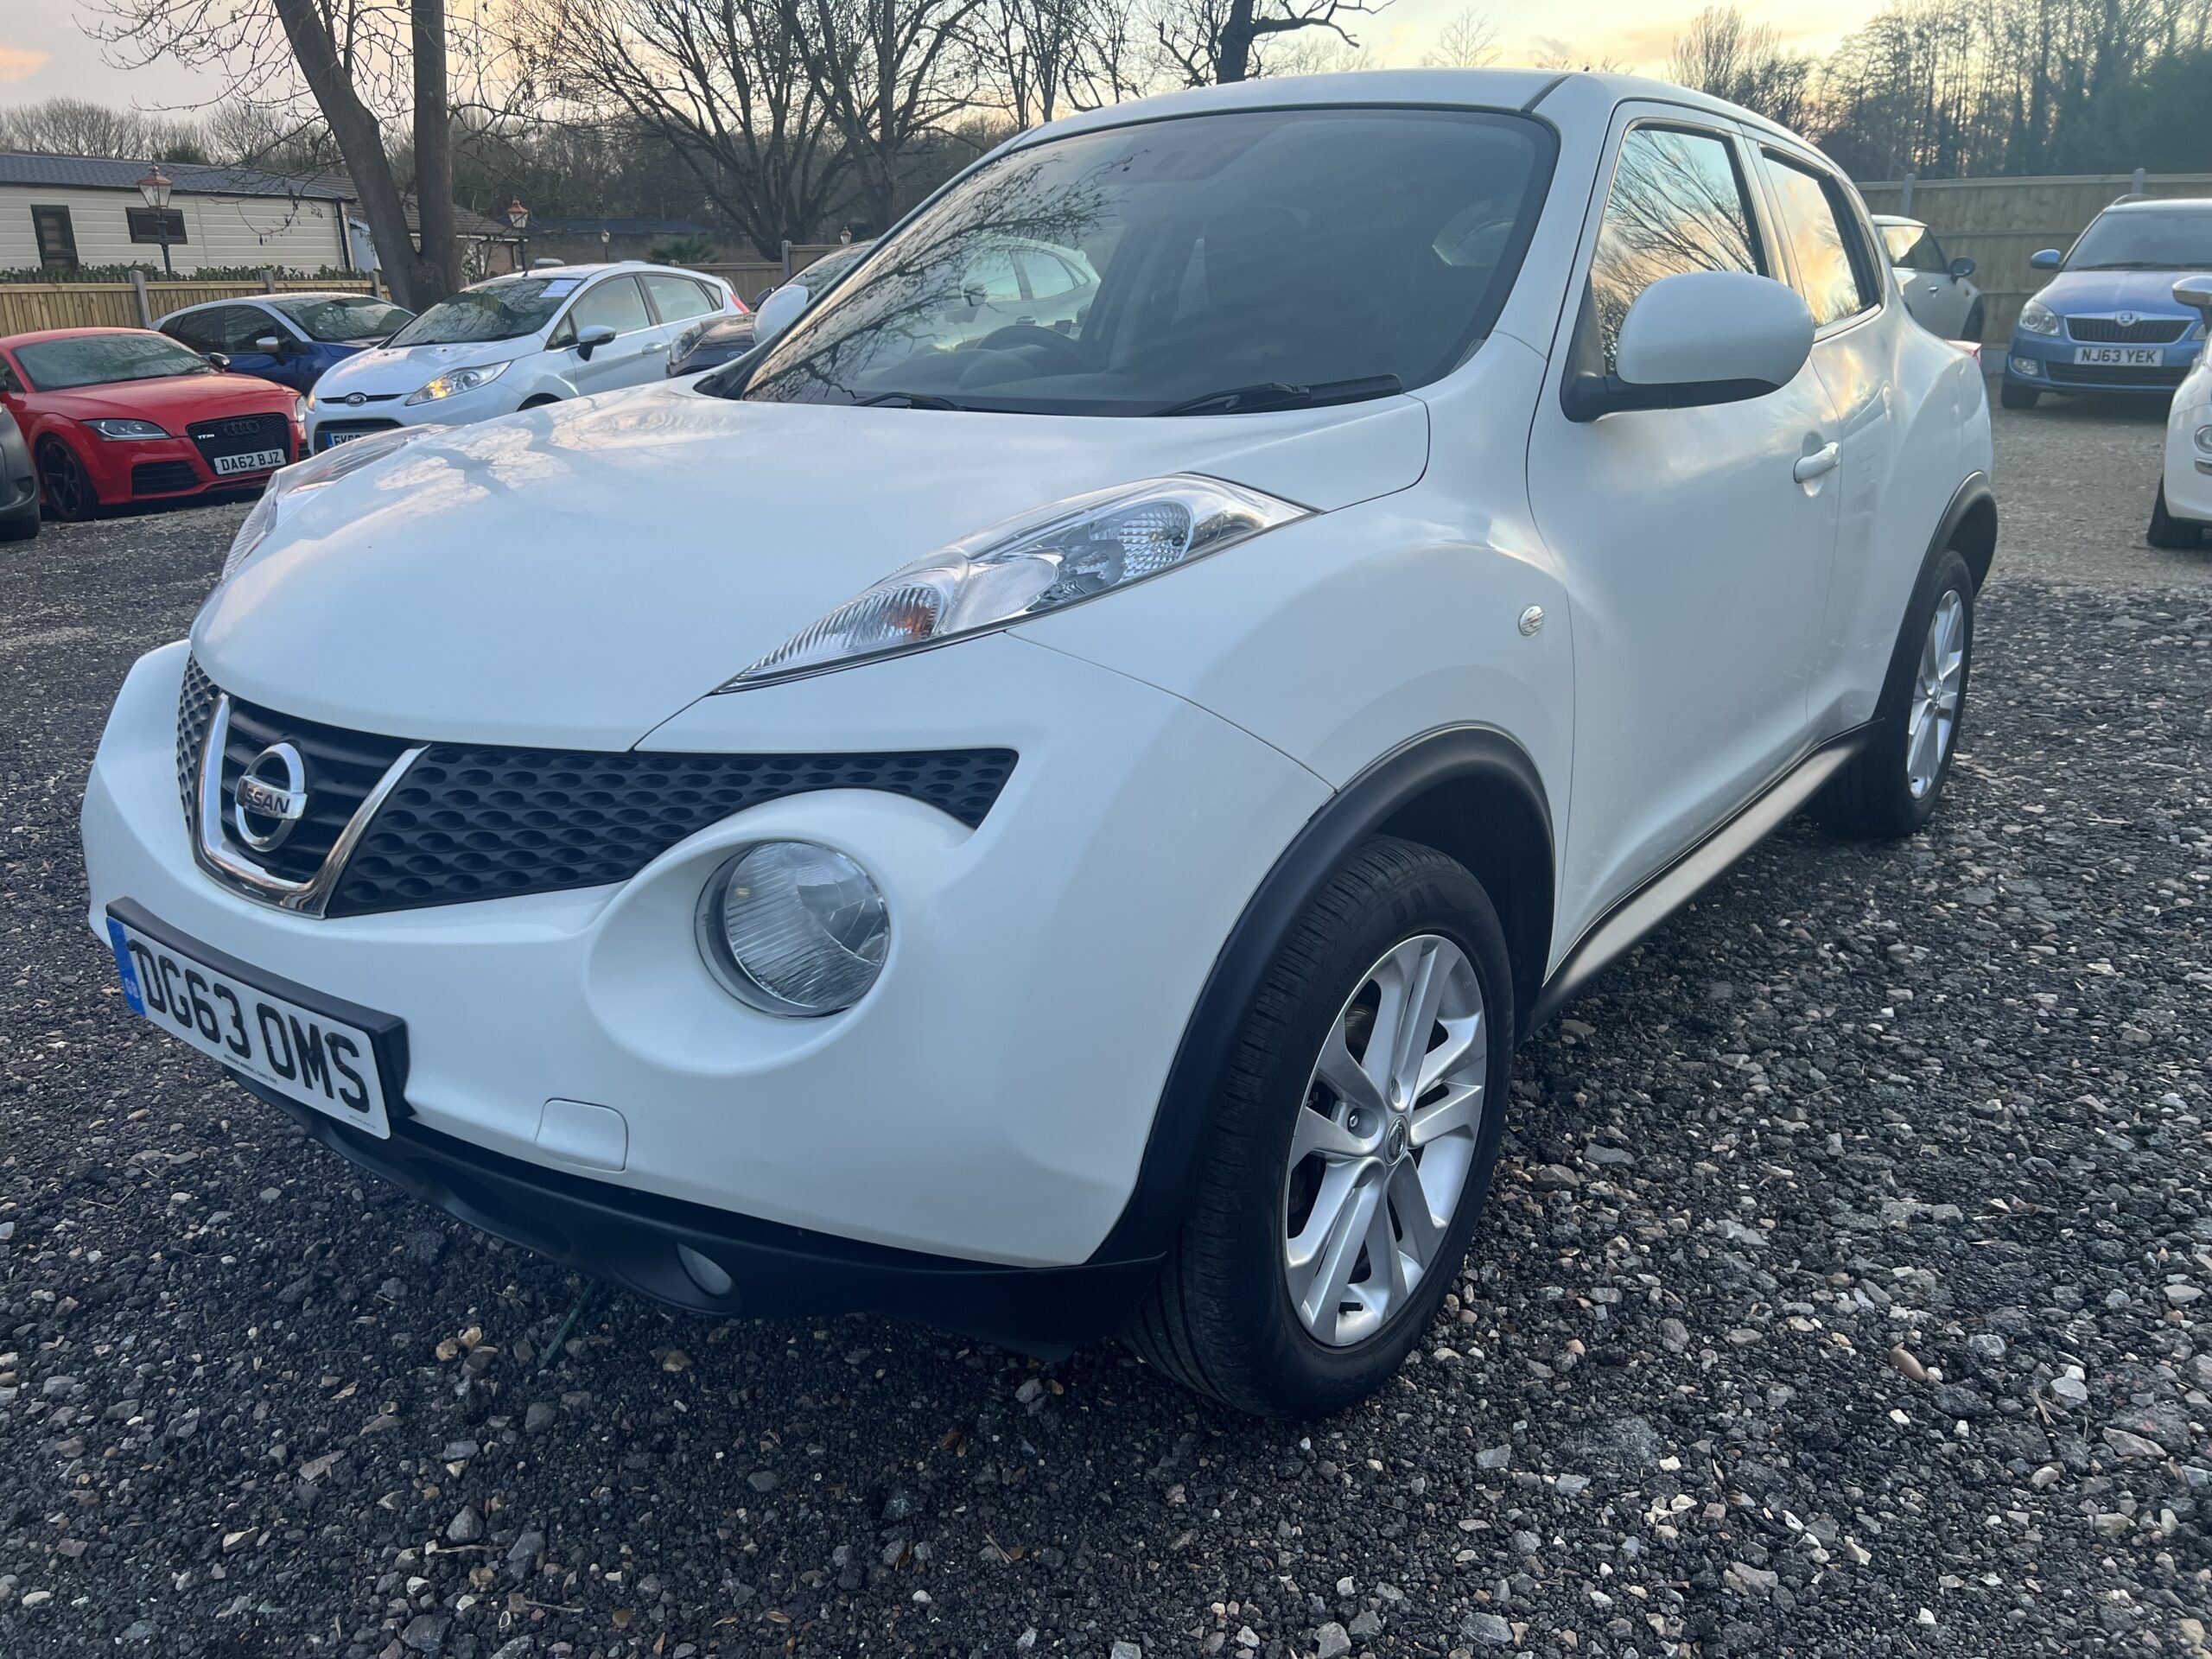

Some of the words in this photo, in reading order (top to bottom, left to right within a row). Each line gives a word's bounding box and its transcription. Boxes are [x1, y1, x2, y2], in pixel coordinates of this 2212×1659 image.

[2081, 347, 2122, 363] NJ63
[2126, 348, 2157, 363] YEK
[220, 457, 256, 471] DA62
[257, 451, 281, 466] BJZ
[238, 781, 290, 814] SSAN
[127, 938, 252, 1059] DG63
[257, 1002, 371, 1114] OMS
